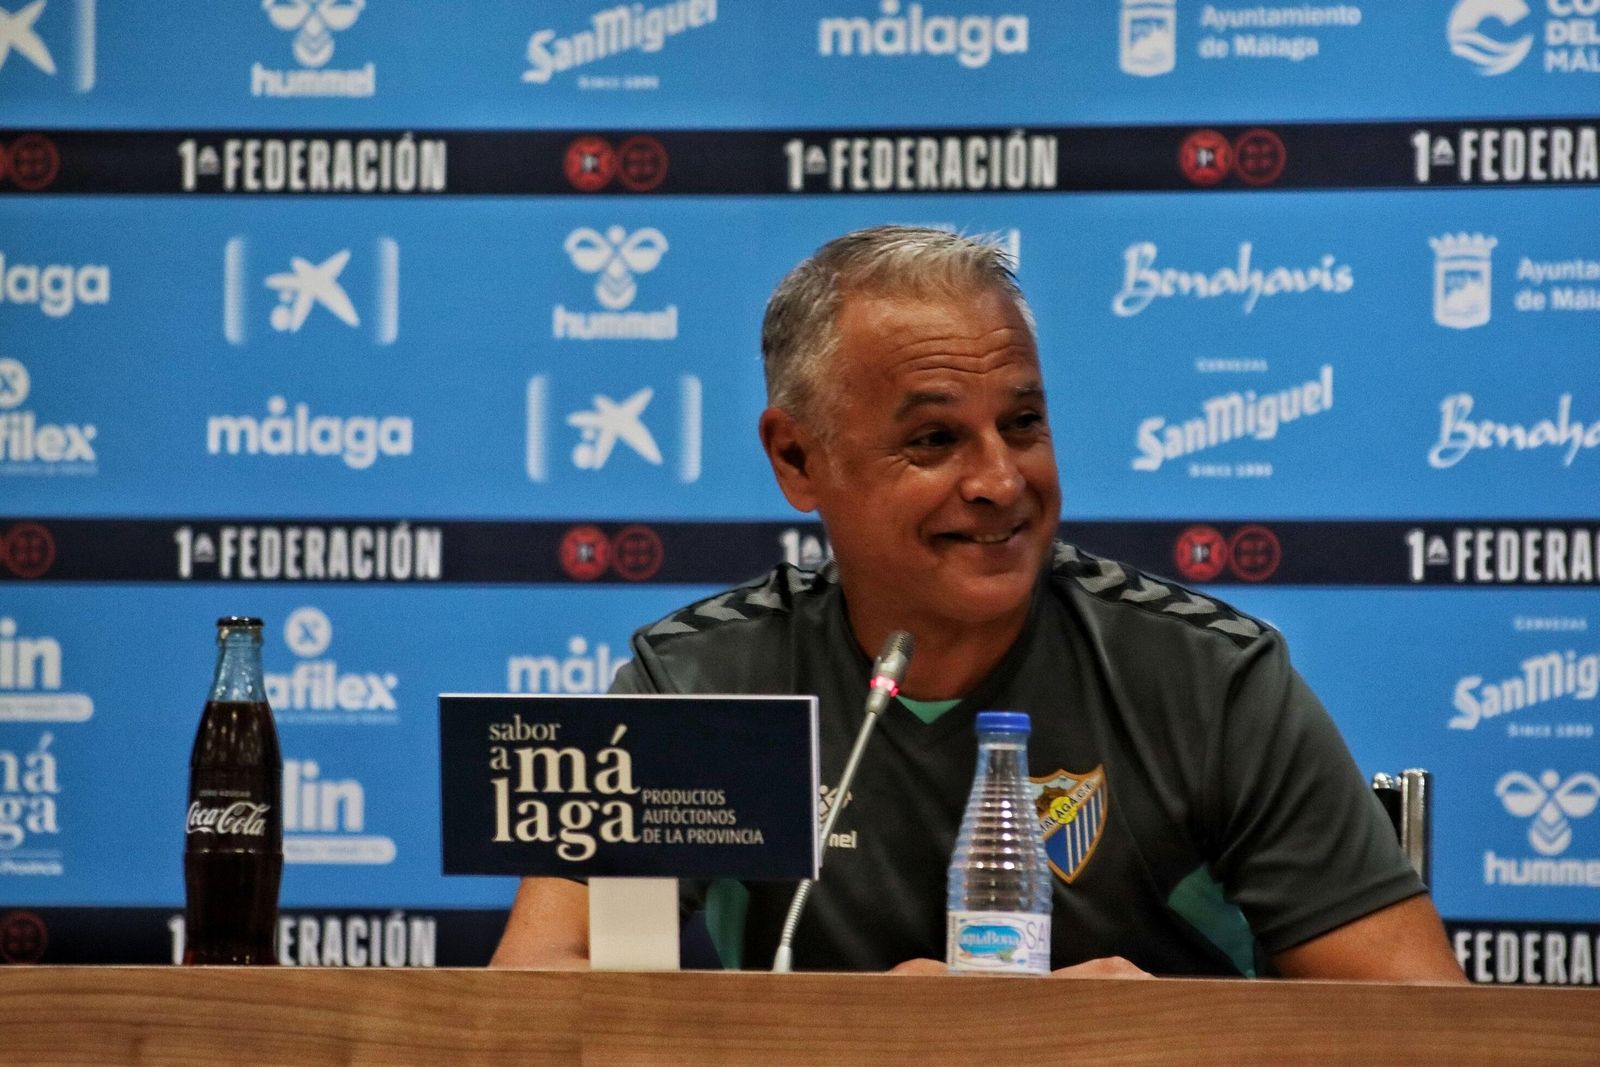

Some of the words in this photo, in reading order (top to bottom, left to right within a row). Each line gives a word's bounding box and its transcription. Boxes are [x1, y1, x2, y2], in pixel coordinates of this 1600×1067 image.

[1202, 4, 1362, 32] Ayuntamiento
[1199, 34, 1229, 58] de
[251, 62, 376, 97] hummel
[223, 132, 448, 192] FEDERACIÓN
[829, 130, 1059, 190] FEDERACIÓN
[1458, 126, 1600, 182] FEDERA
[1513, 288, 1546, 311] de
[552, 304, 679, 340] hummel
[219, 522, 443, 580] FEDERACIÓN
[1454, 528, 1600, 582] FEDERA
[488, 714, 561, 741] sabor
[642, 789, 726, 805] PRODUCTOS
[642, 807, 737, 825] AUTÓCTONOS
[642, 829, 662, 844] DE
[665, 829, 684, 844] LA
[687, 829, 765, 845] PROVINCIA
[277, 909, 438, 968] ERACIÓN
[1454, 929, 1600, 985] FEDERA
